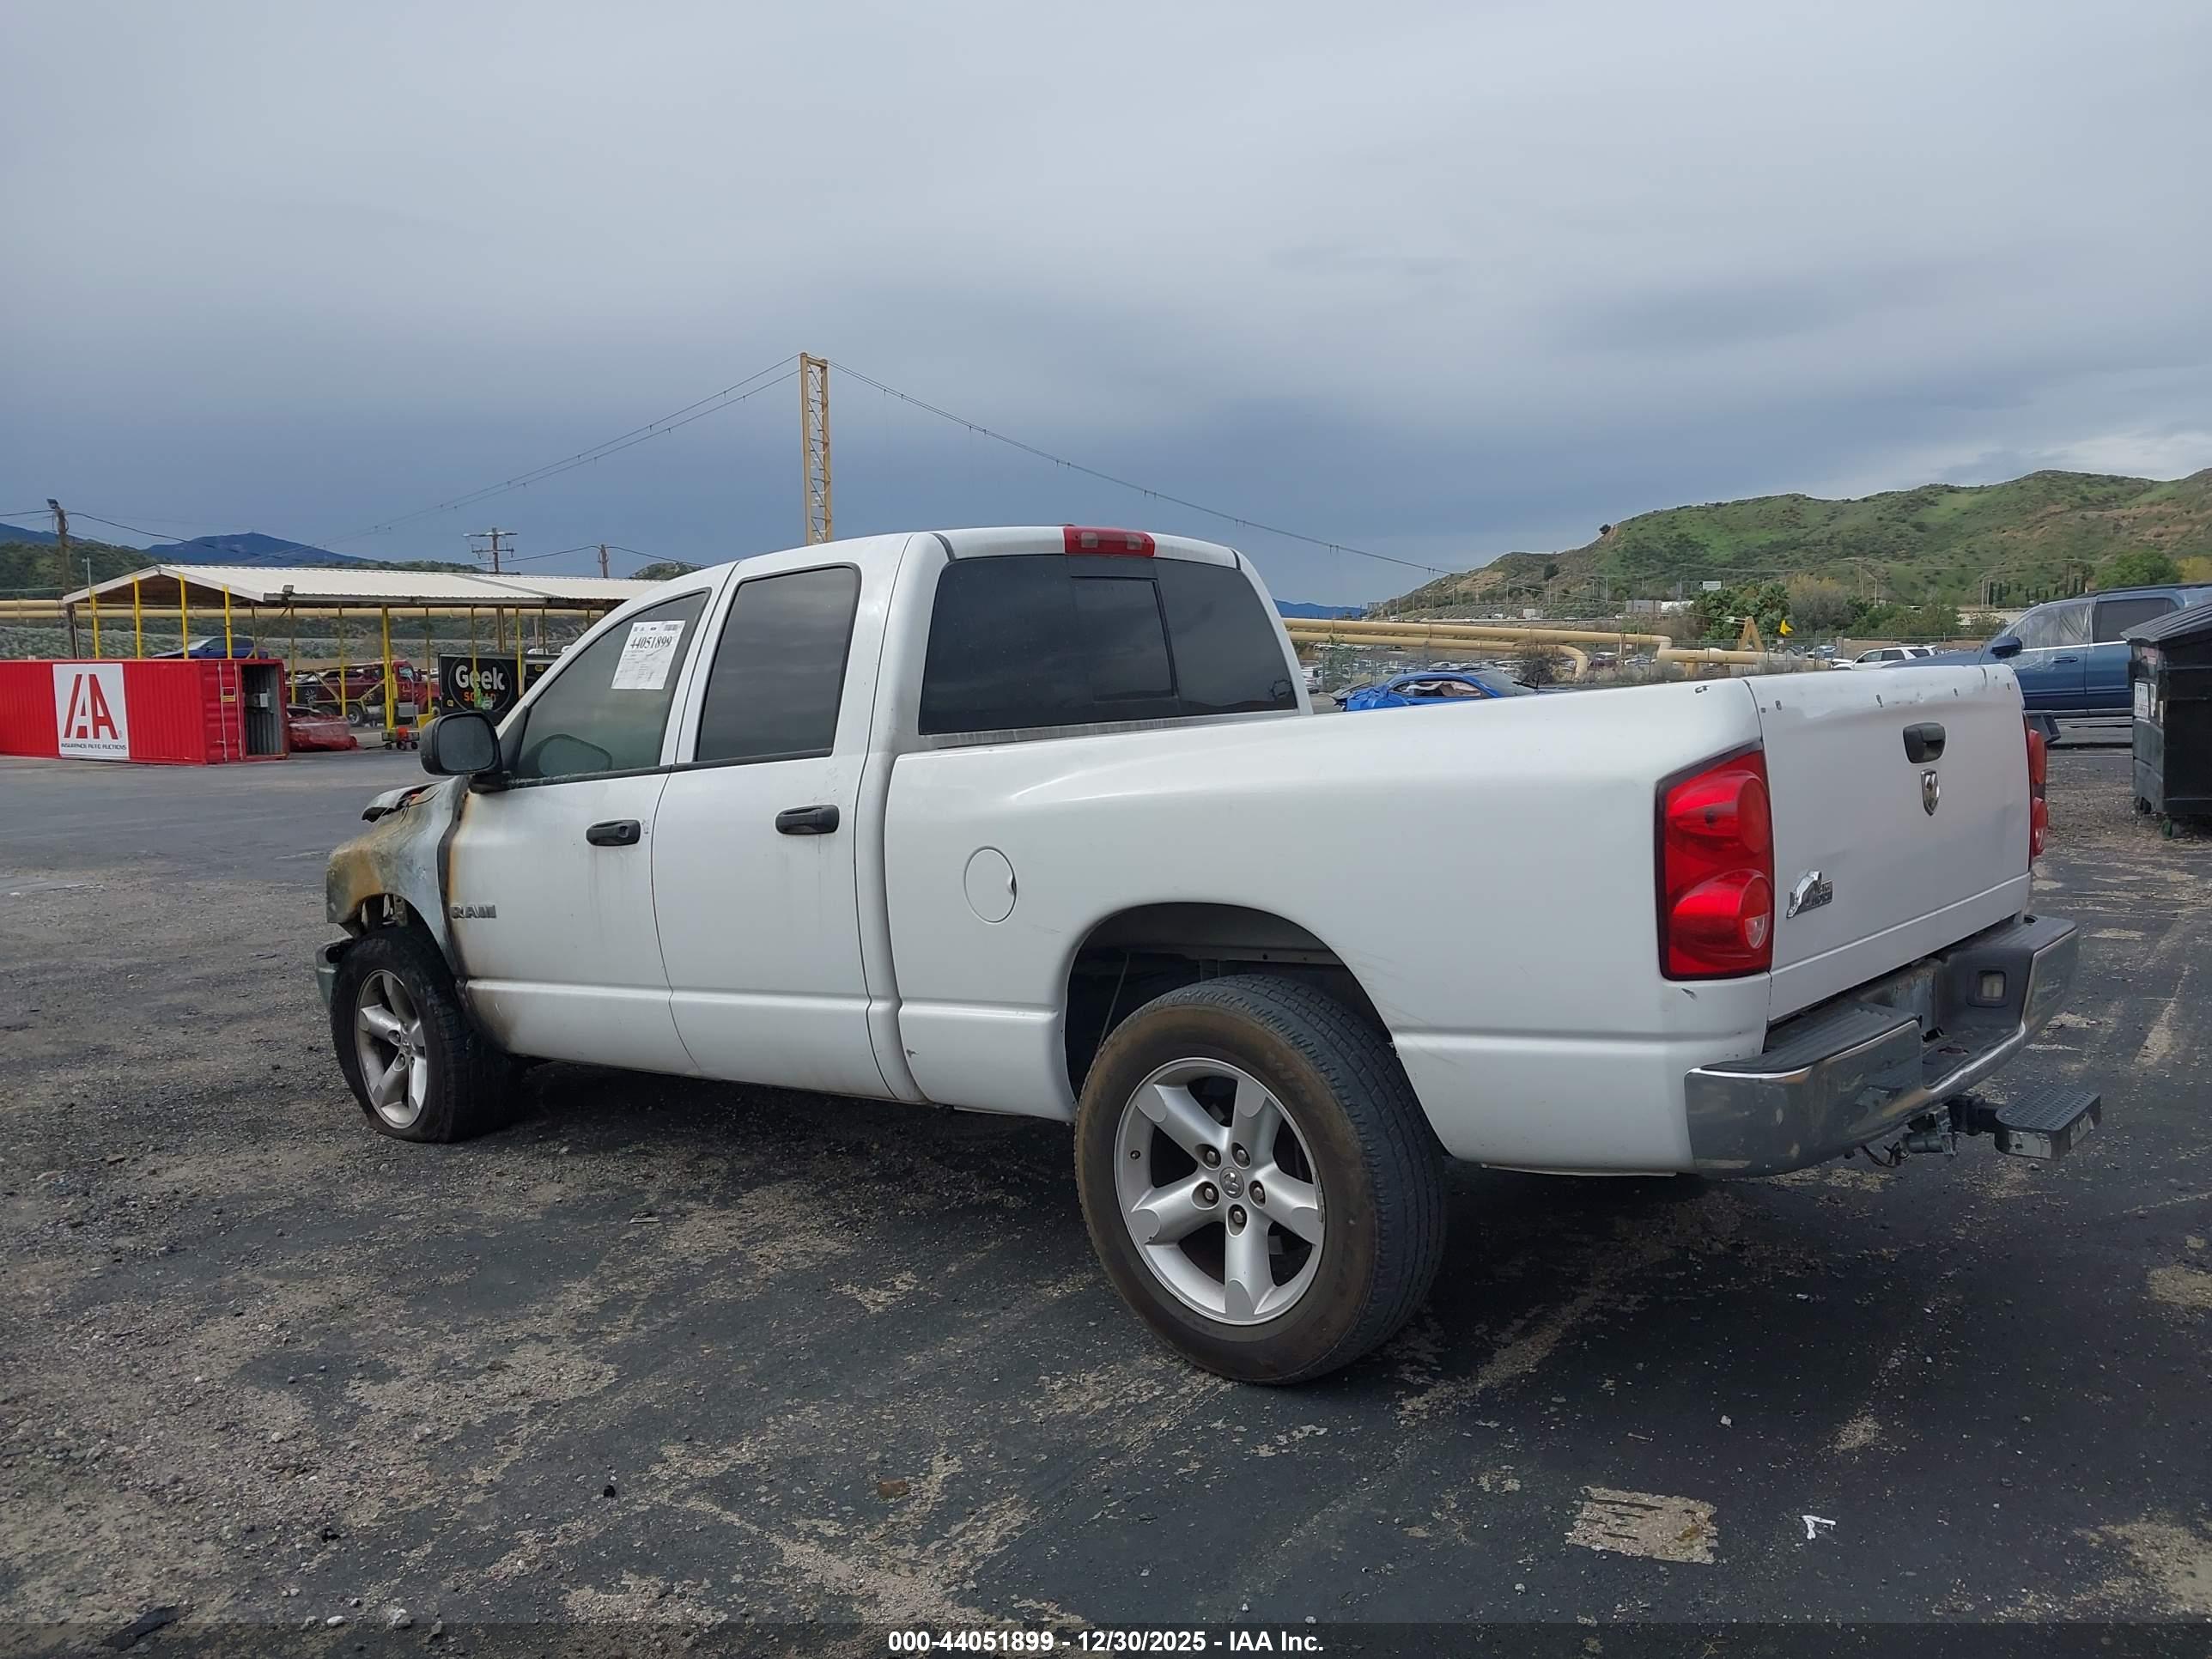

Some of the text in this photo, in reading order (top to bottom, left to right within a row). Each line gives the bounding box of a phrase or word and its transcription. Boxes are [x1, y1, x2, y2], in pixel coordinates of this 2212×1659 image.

[630, 635, 672, 649] 44051899
[455, 665, 505, 690] Geek
[449, 905, 497, 919] RAM
